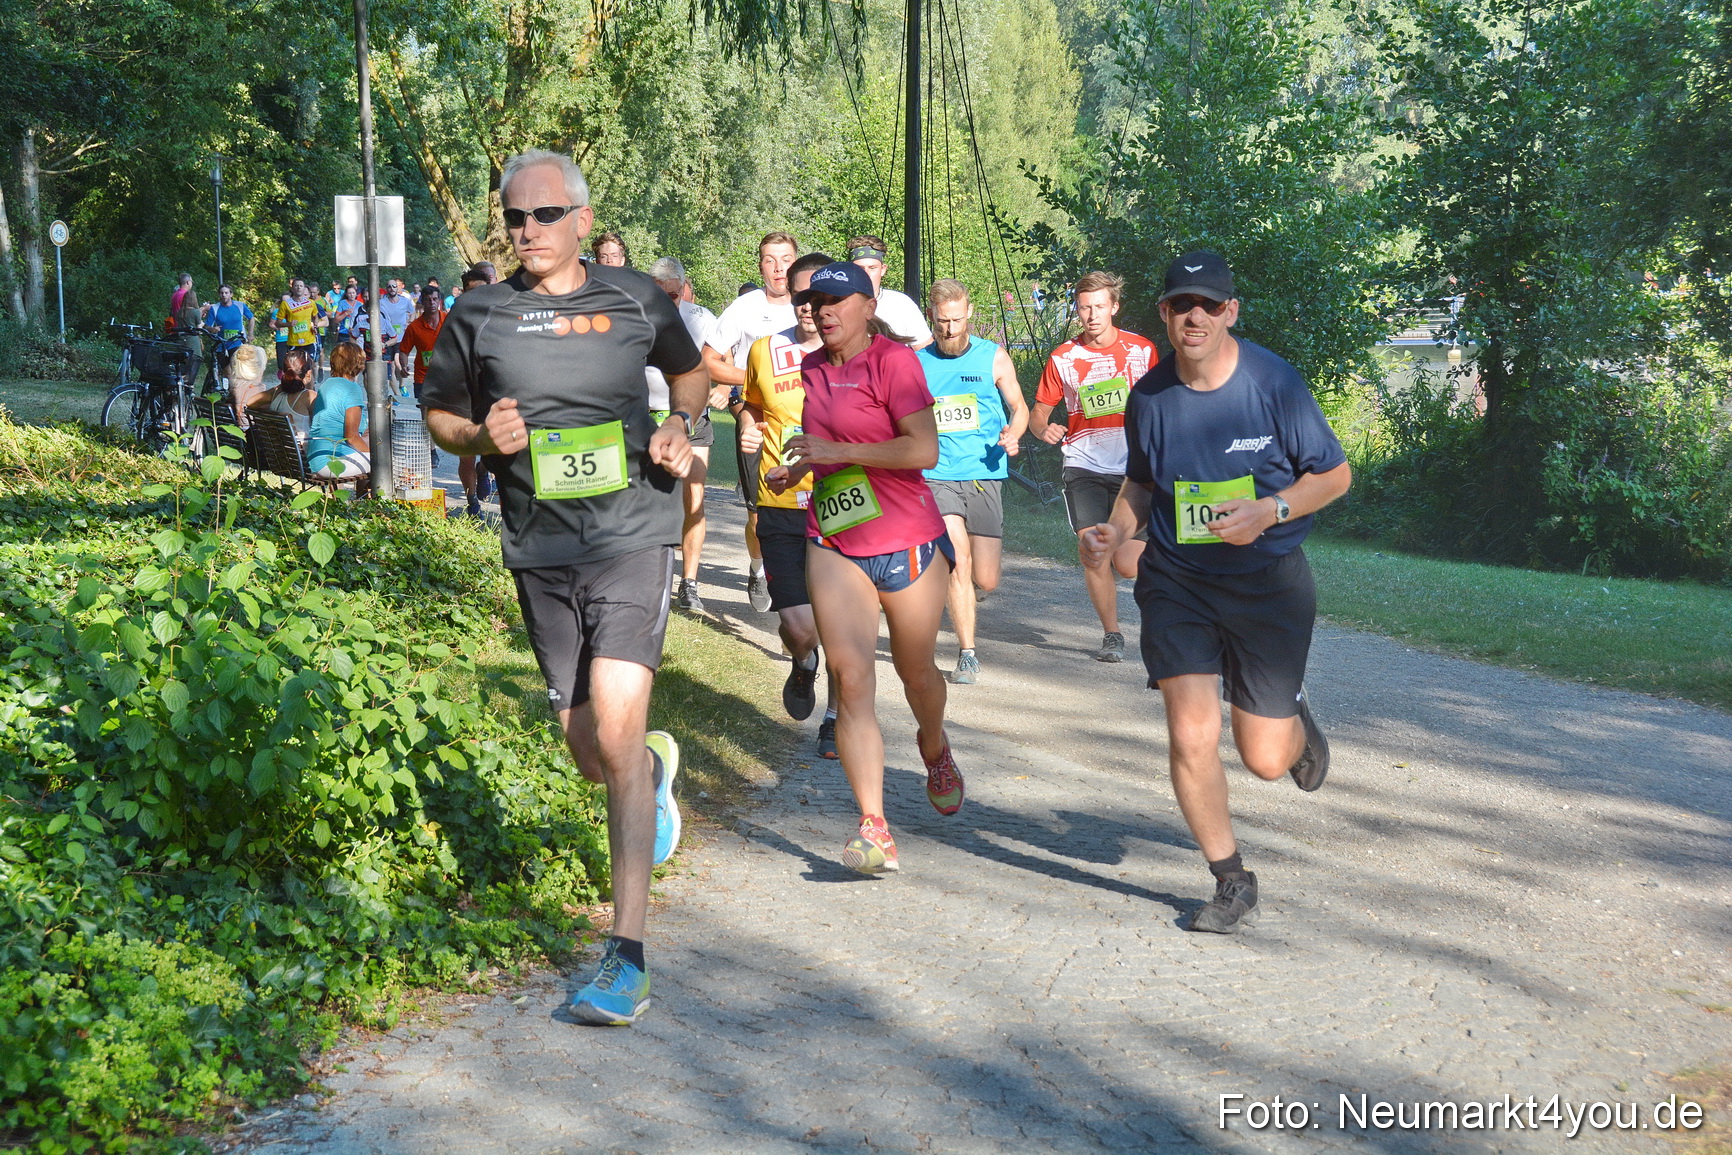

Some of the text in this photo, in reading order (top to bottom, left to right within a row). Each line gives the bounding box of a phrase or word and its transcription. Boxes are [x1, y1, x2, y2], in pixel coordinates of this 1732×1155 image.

[522, 311, 555, 321] APTIV
[773, 378, 804, 394] MA
[960, 375, 983, 383] THULE
[1087, 390, 1122, 408] 1871
[935, 406, 972, 423] 1939
[561, 452, 597, 478] 35
[554, 475, 609, 487] Schmidt Rainer
[818, 487, 866, 522] 2068
